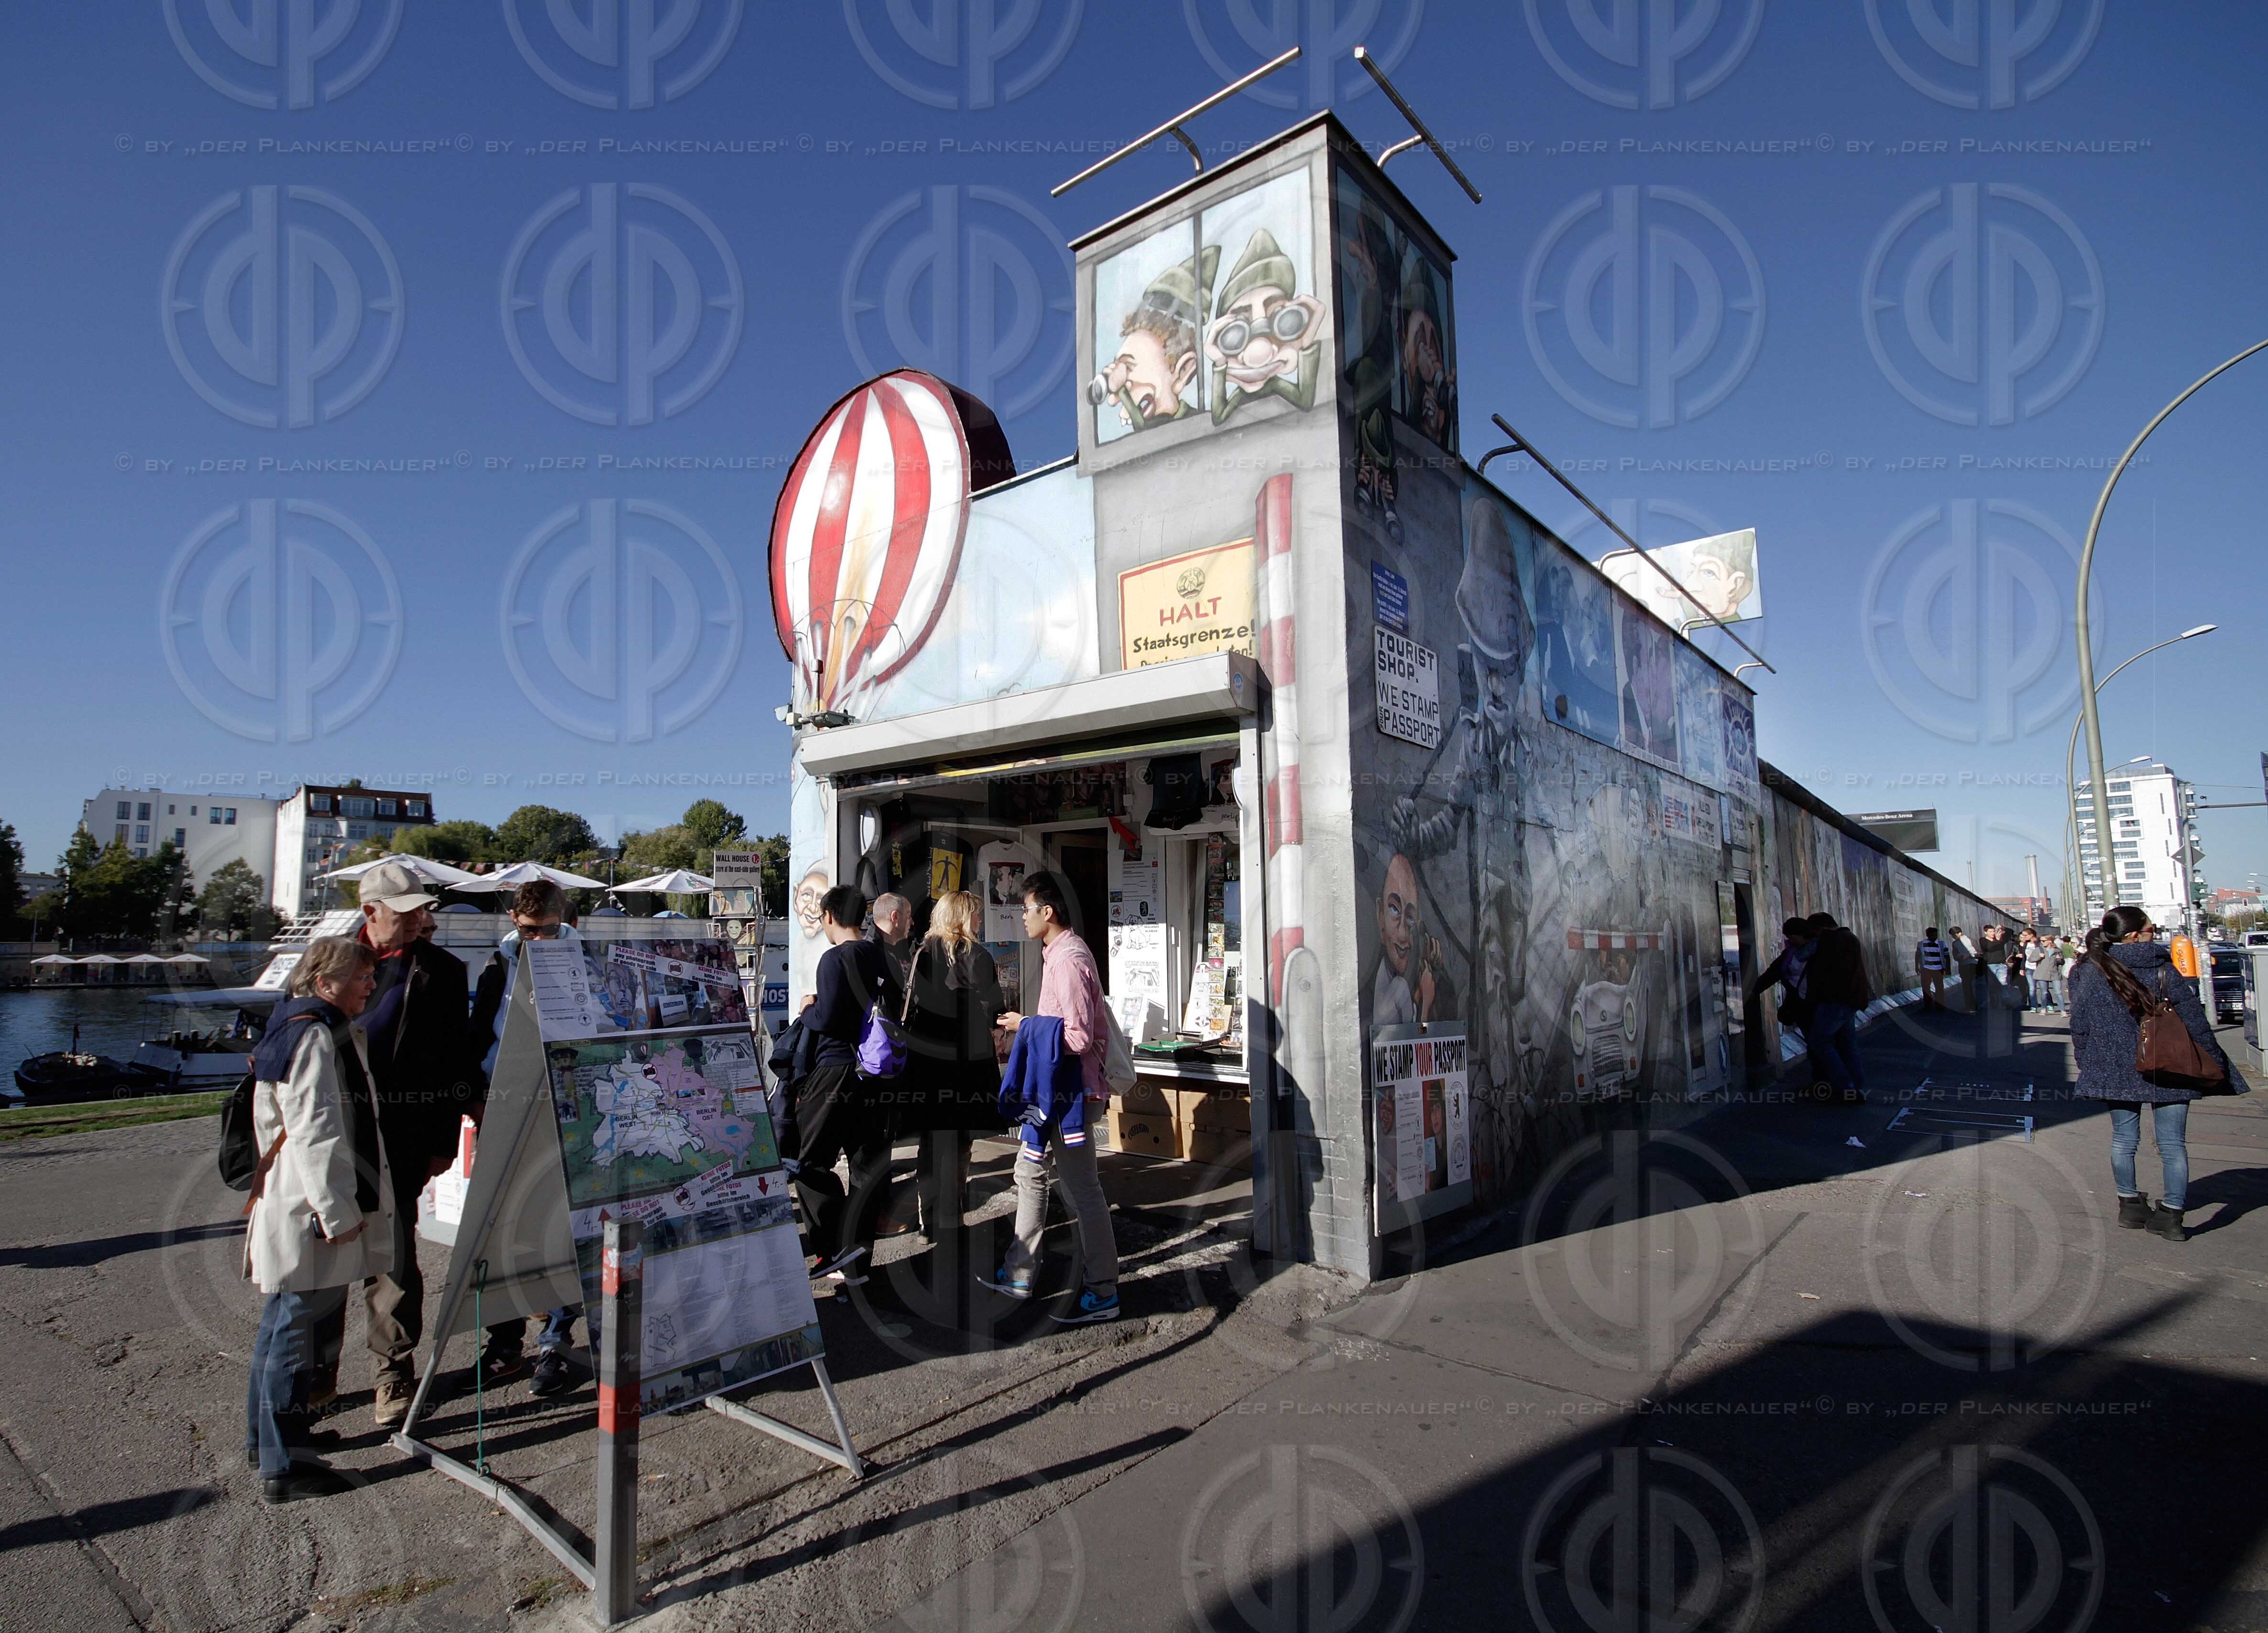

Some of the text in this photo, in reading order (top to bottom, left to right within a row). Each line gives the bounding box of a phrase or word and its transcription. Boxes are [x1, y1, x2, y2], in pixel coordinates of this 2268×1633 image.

[1159, 597, 1221, 626] HALT
[1133, 619, 1256, 653] Staatsgrenze!
[1377, 629, 1434, 671] TOURIST
[1378, 650, 1418, 683] SHOP.
[1378, 680, 1439, 721] WE STAMP
[1384, 708, 1439, 745] PASSPORT
[615, 947, 635, 956] PLEASE
[626, 955, 655, 966] photograph
[763, 989, 788, 1003] HOS
[1375, 1039, 1466, 1083] WE STAMP YOUR PASSPORT
[716, 1162, 731, 1173] FOTOS
[621, 1201, 642, 1210] PLEASE
